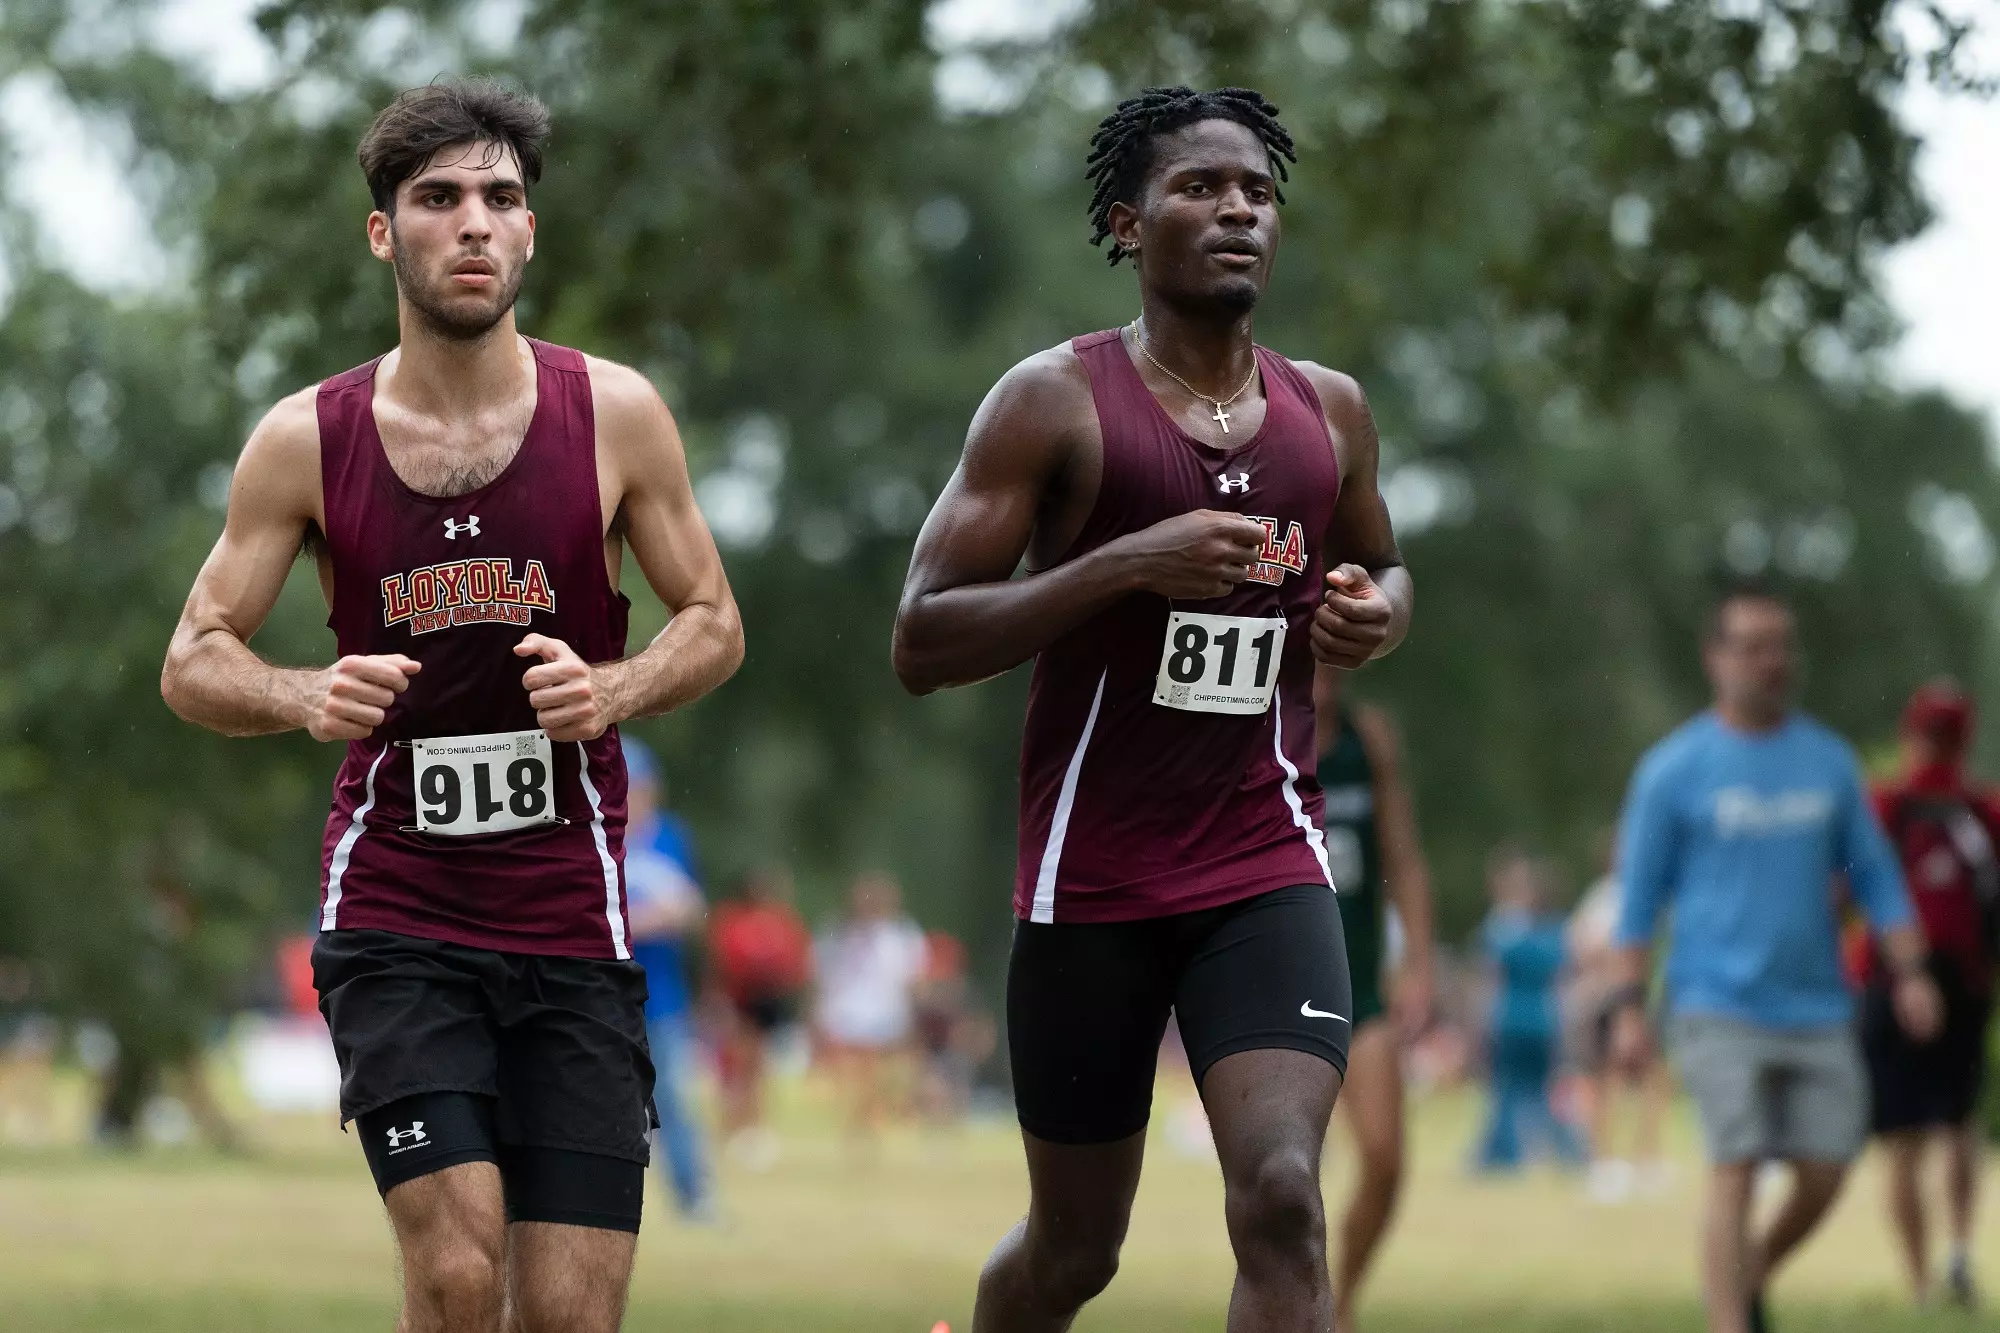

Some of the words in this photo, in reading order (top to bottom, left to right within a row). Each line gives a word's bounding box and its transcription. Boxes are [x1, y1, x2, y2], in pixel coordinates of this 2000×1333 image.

[1246, 563, 1285, 586] EANS
[381, 558, 555, 627] LOYOLA
[411, 609, 450, 636] NEW
[451, 603, 531, 626] ORLEANS
[1167, 624, 1275, 688] 811
[1193, 694, 1265, 705] CHIPPEDTIMING.COM
[426, 743, 511, 756] CHIPPEDTIMING.COM
[420, 757, 547, 825] 816
